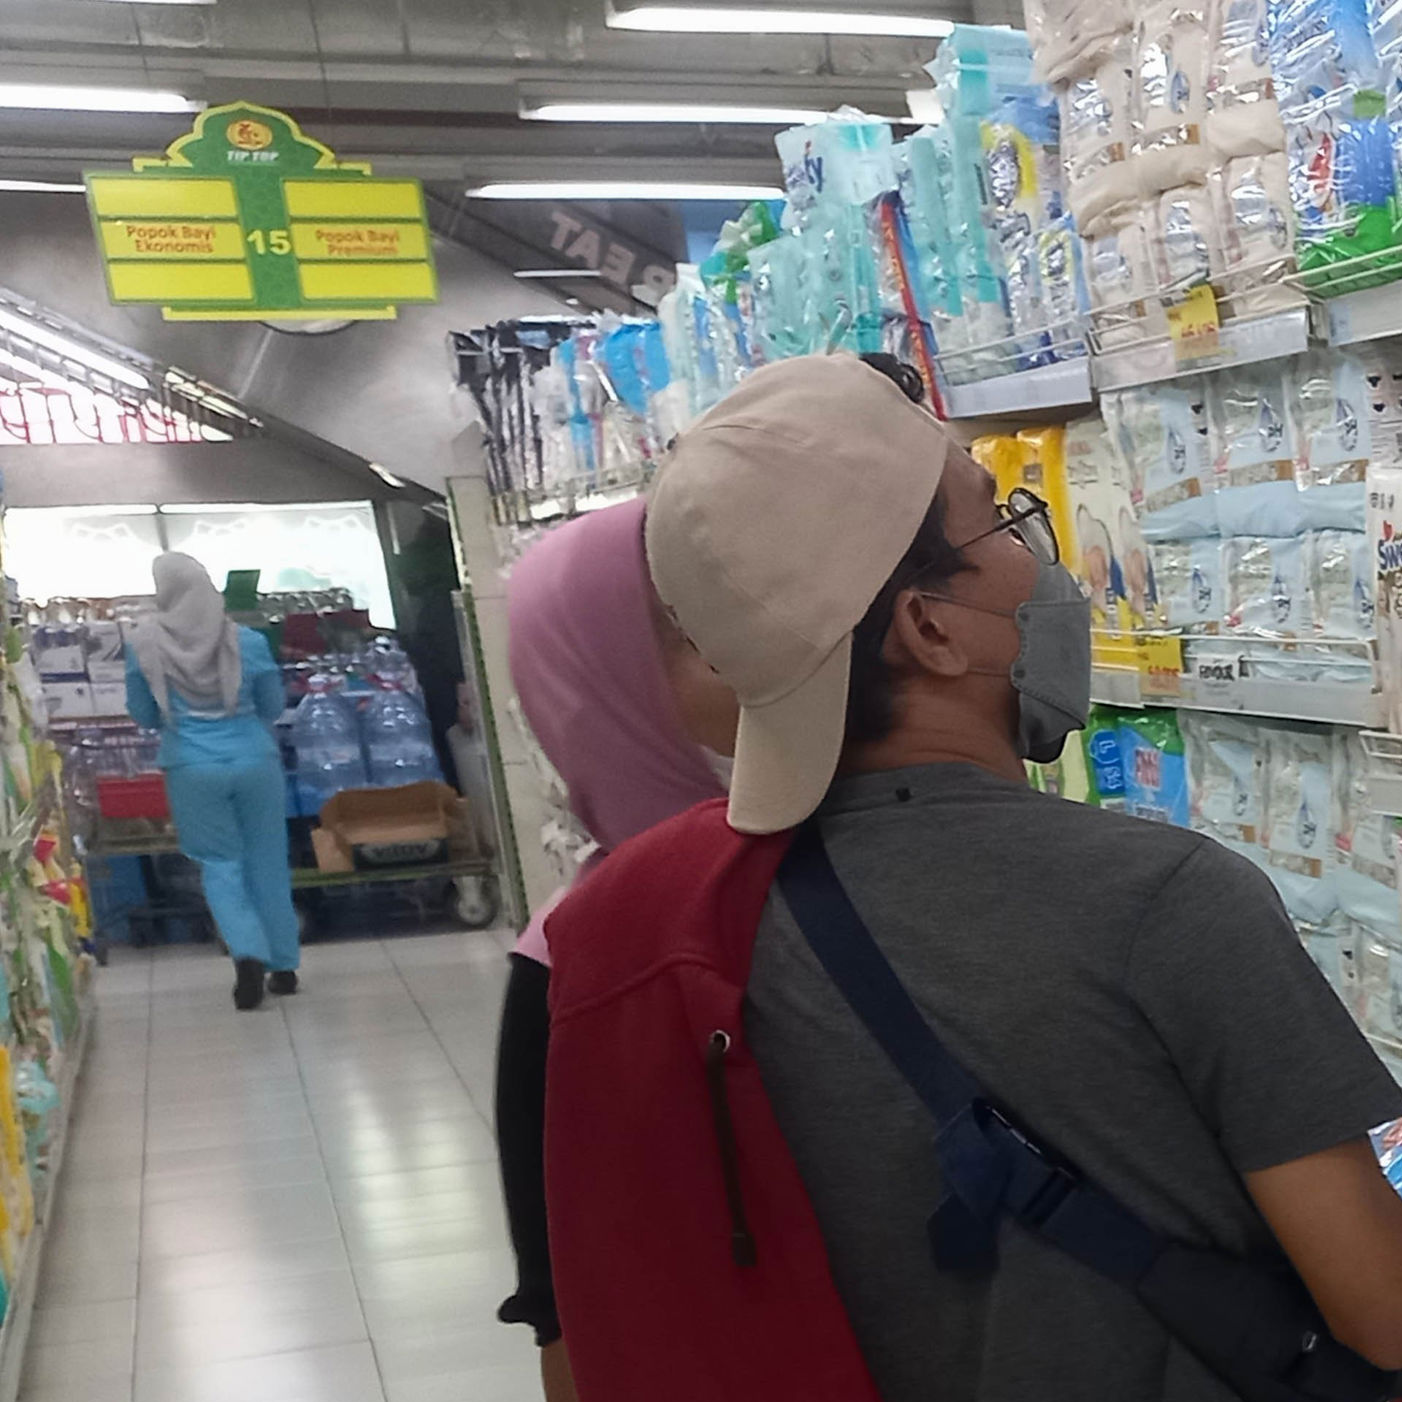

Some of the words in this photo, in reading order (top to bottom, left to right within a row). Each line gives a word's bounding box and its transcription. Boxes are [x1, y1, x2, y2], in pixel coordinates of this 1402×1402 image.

[126, 225, 175, 241] Popok
[182, 225, 216, 240] Bayi
[315, 230, 366, 244] Popok
[369, 230, 399, 244] Bayi
[135, 239, 214, 254] Ekonomis
[247, 229, 291, 256] 15
[327, 244, 399, 257] Premium
